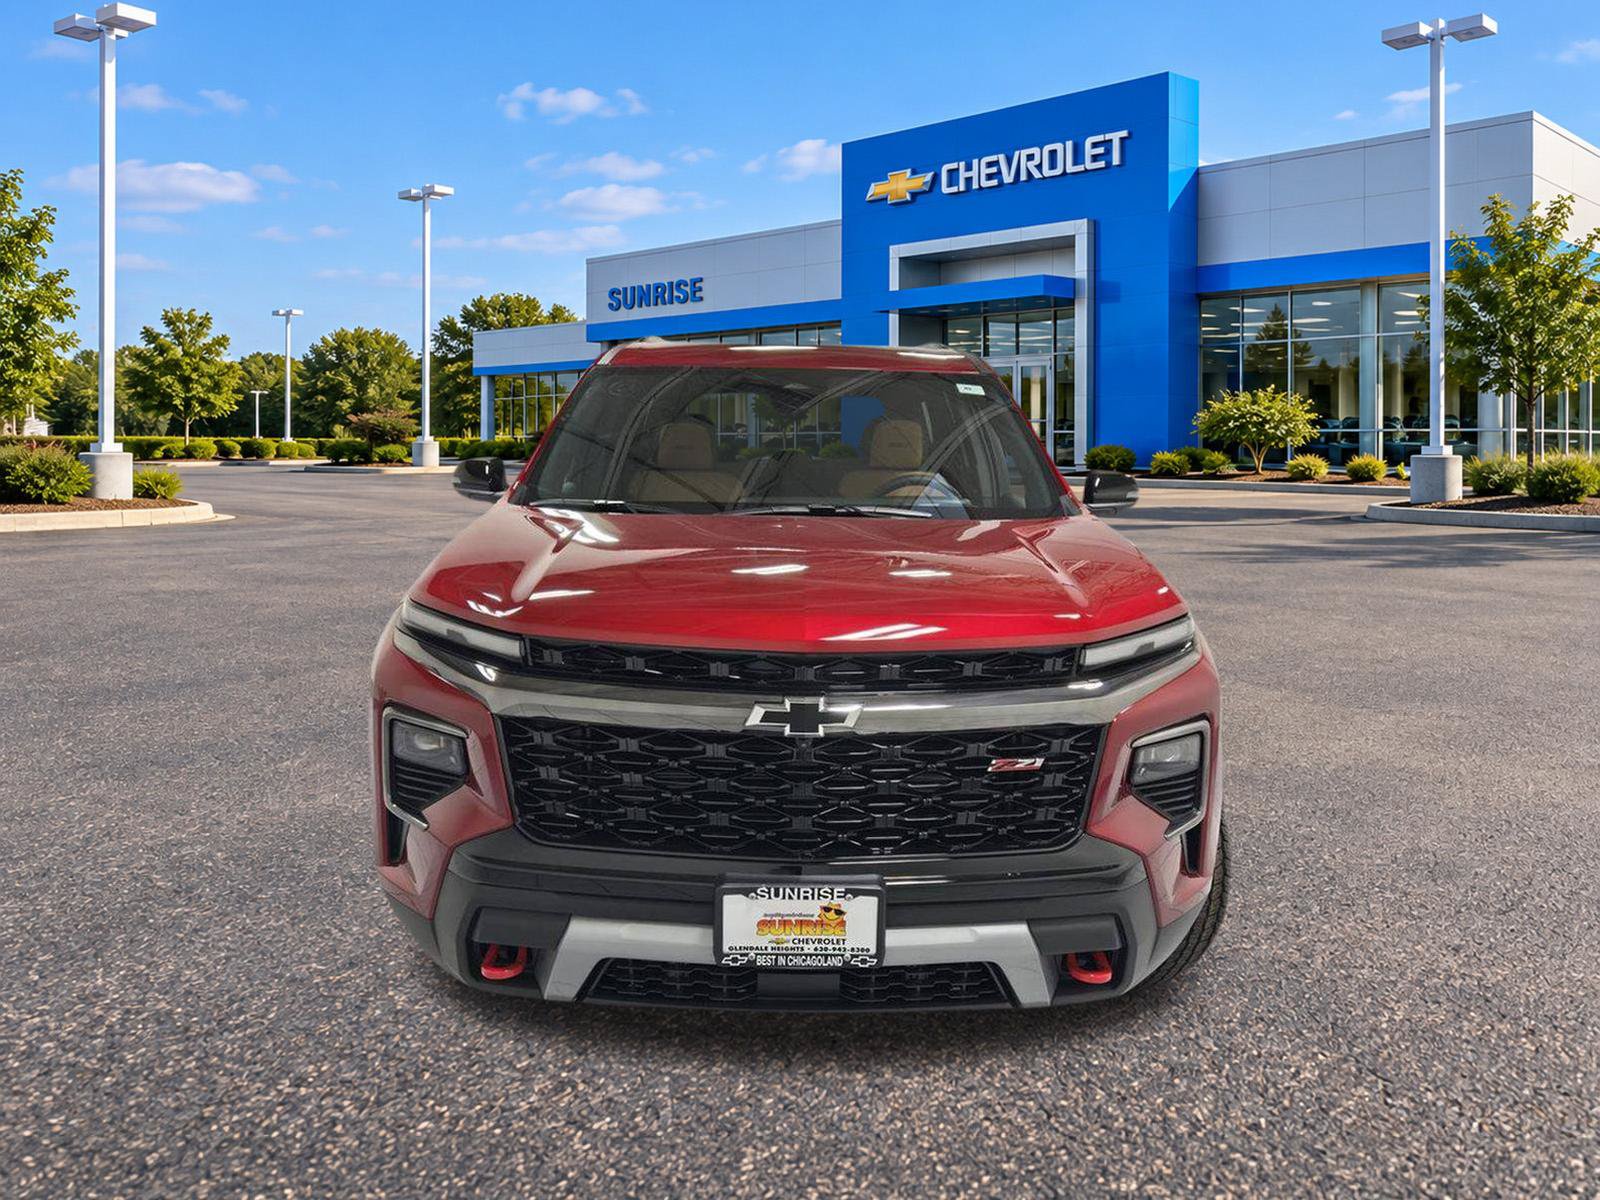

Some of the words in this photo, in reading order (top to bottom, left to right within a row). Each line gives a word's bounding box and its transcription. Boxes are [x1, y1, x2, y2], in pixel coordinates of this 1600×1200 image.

[941, 130, 1129, 194] CHEVROLET
[608, 277, 704, 312] SUNRISE
[756, 887, 845, 900] SUNRISE
[756, 919, 847, 936] SUNRISE
[756, 956, 775, 966] BEST
[776, 956, 787, 966] IN
[787, 956, 844, 966] CHICAGOLAND
